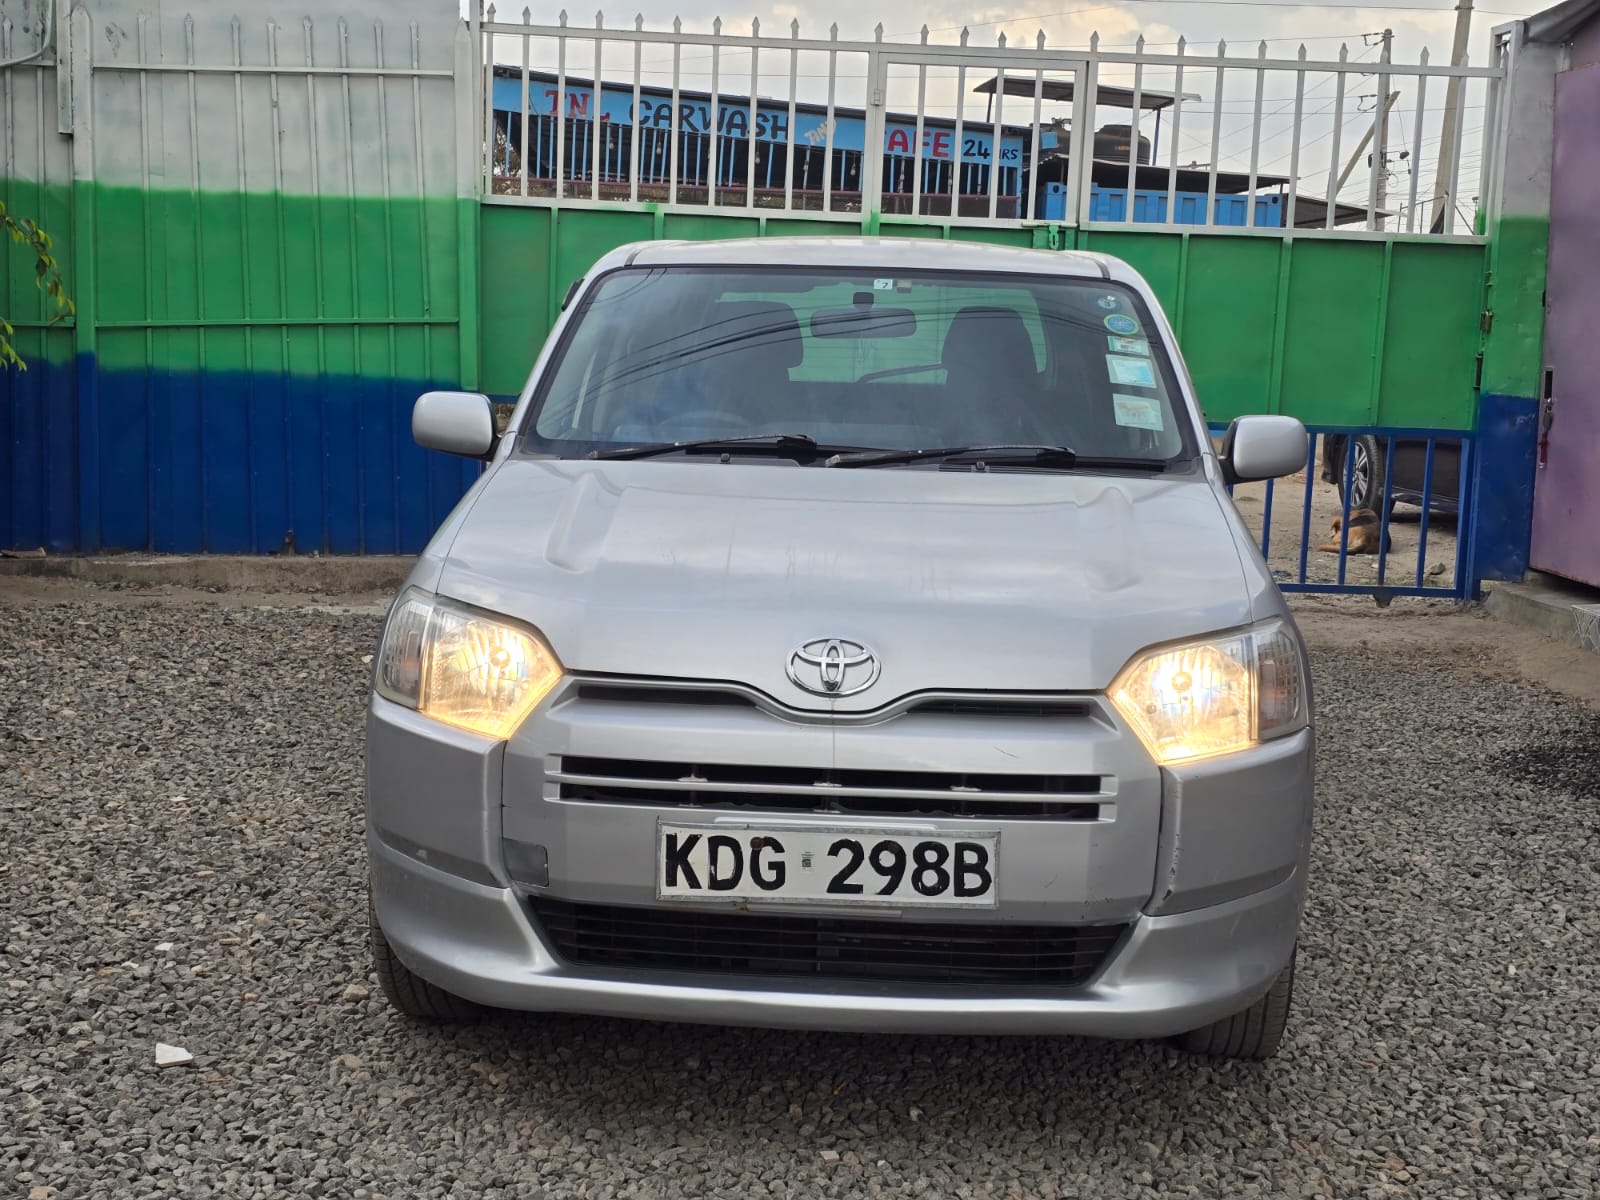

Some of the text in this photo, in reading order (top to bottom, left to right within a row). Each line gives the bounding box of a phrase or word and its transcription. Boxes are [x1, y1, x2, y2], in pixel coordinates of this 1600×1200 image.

[628, 100, 789, 140] CARWASH
[884, 129, 950, 158] AFE
[963, 139, 990, 159] 24
[998, 147, 1018, 160] RS
[665, 833, 992, 897] KDG 298B
